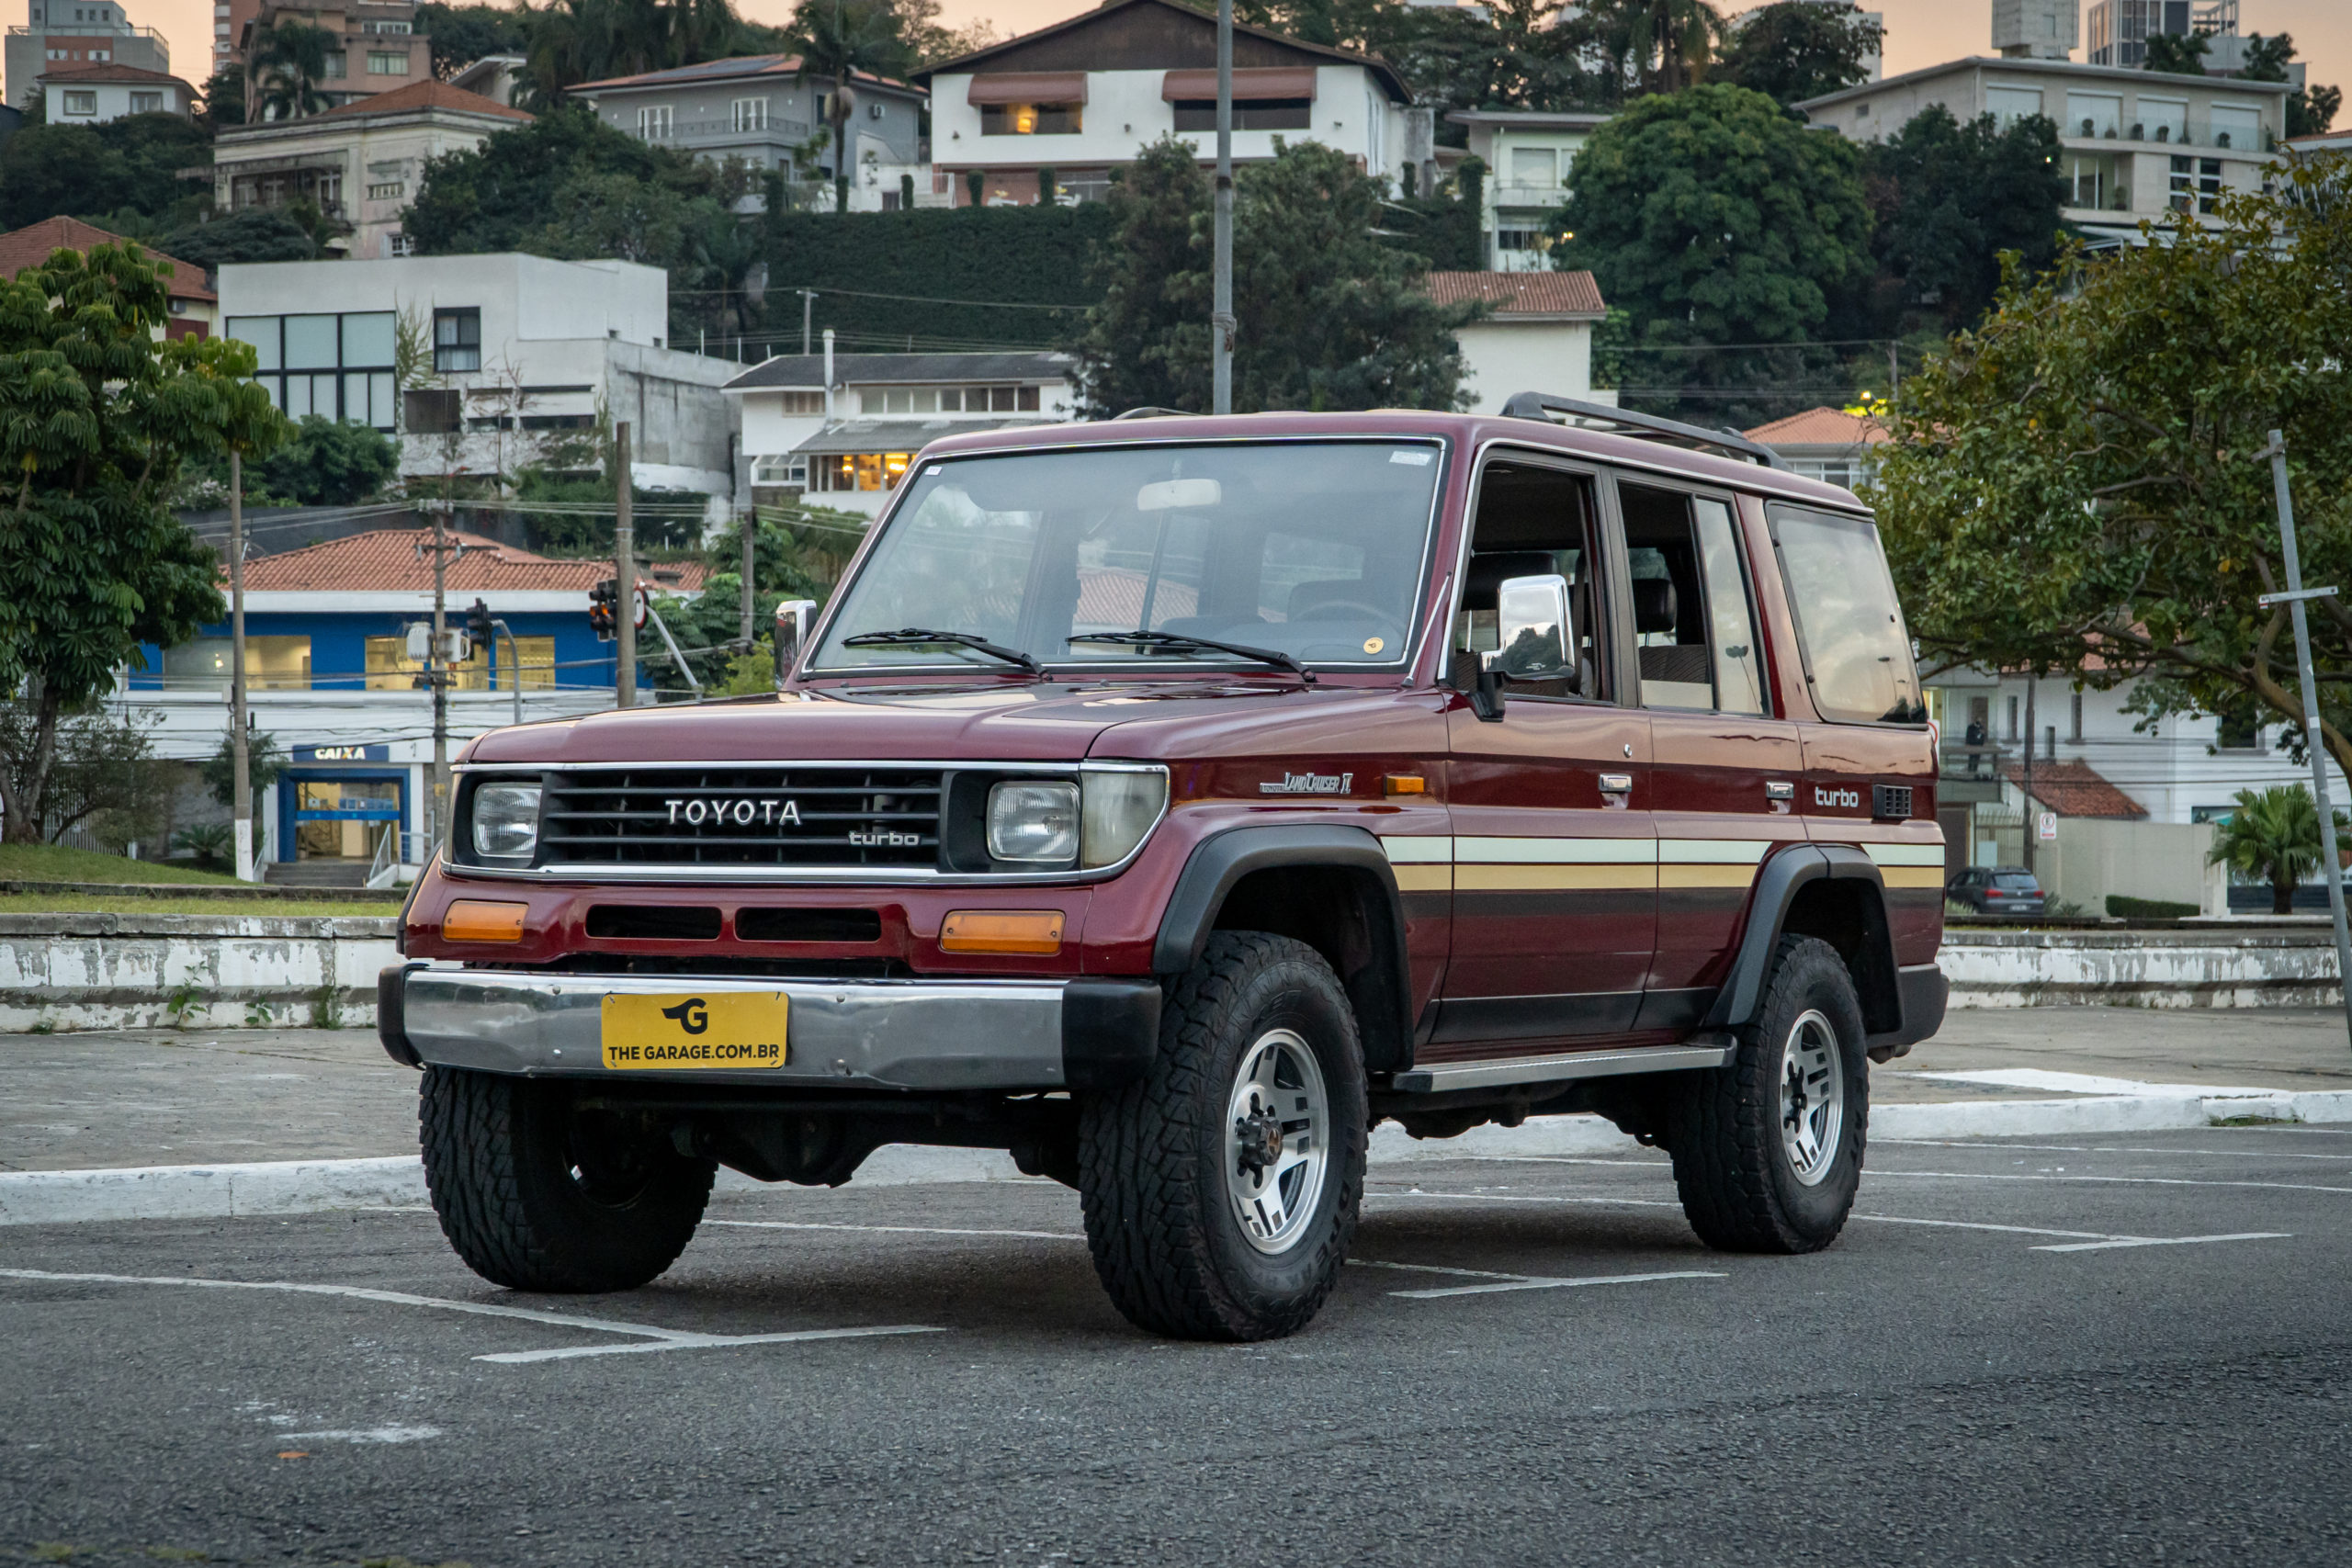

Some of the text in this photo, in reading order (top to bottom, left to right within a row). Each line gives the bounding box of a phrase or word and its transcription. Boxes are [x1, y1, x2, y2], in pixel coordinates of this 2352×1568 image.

[314, 747, 366, 760] CAIXA
[1815, 786, 1859, 808] turbo
[664, 798, 802, 826] TOYOTA
[848, 830, 921, 847] turbo
[608, 1043, 780, 1061] THE GARAGE.COM.BR
